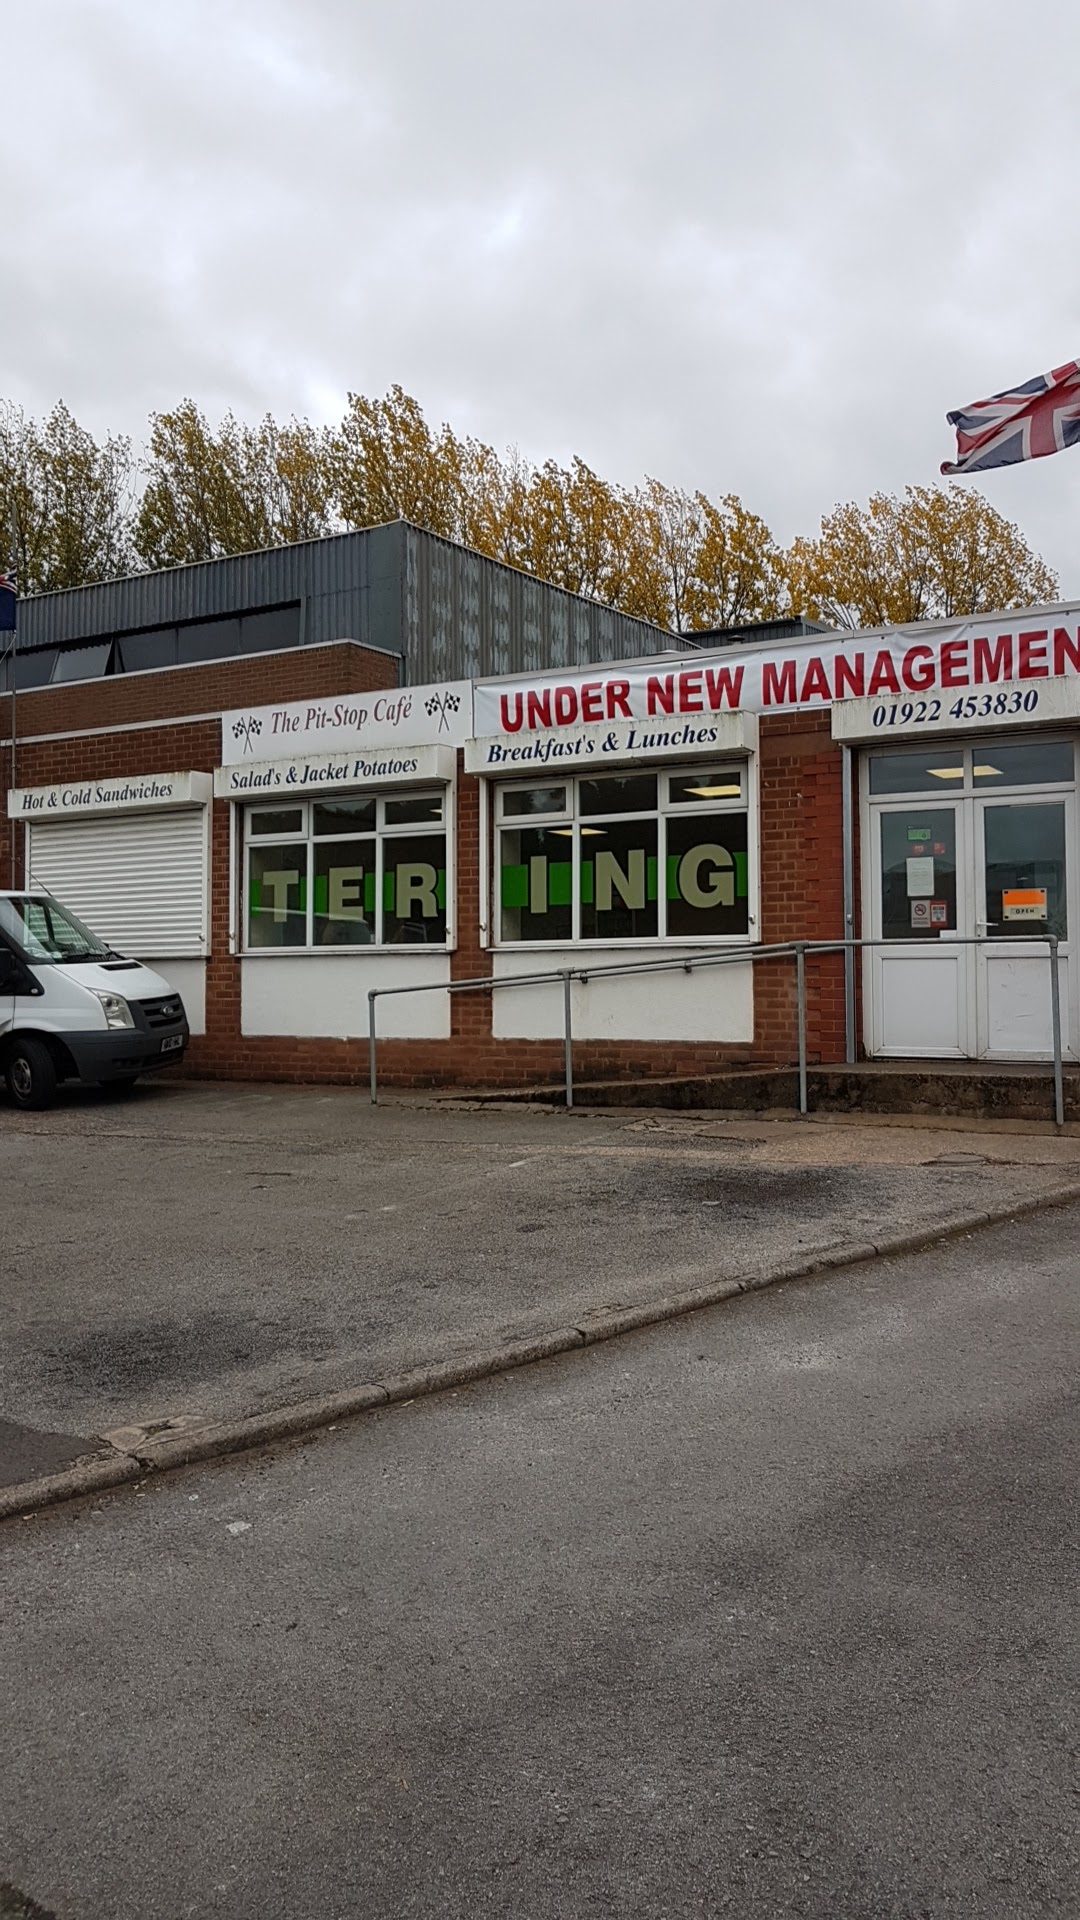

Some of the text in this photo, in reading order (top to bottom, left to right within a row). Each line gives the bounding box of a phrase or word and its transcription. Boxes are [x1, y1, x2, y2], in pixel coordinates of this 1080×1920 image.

[271, 694, 413, 734] The Pit-Stop Café
[500, 679, 633, 733] UNDER
[646, 665, 745, 716] NEW
[872, 689, 1039, 728] 01922 453830
[487, 724, 718, 763] Breakfast's & Lunches
[230, 757, 418, 790] Salad's & Jacket Potatoes
[22, 781, 173, 810] Hot & Cold Sandwiches
